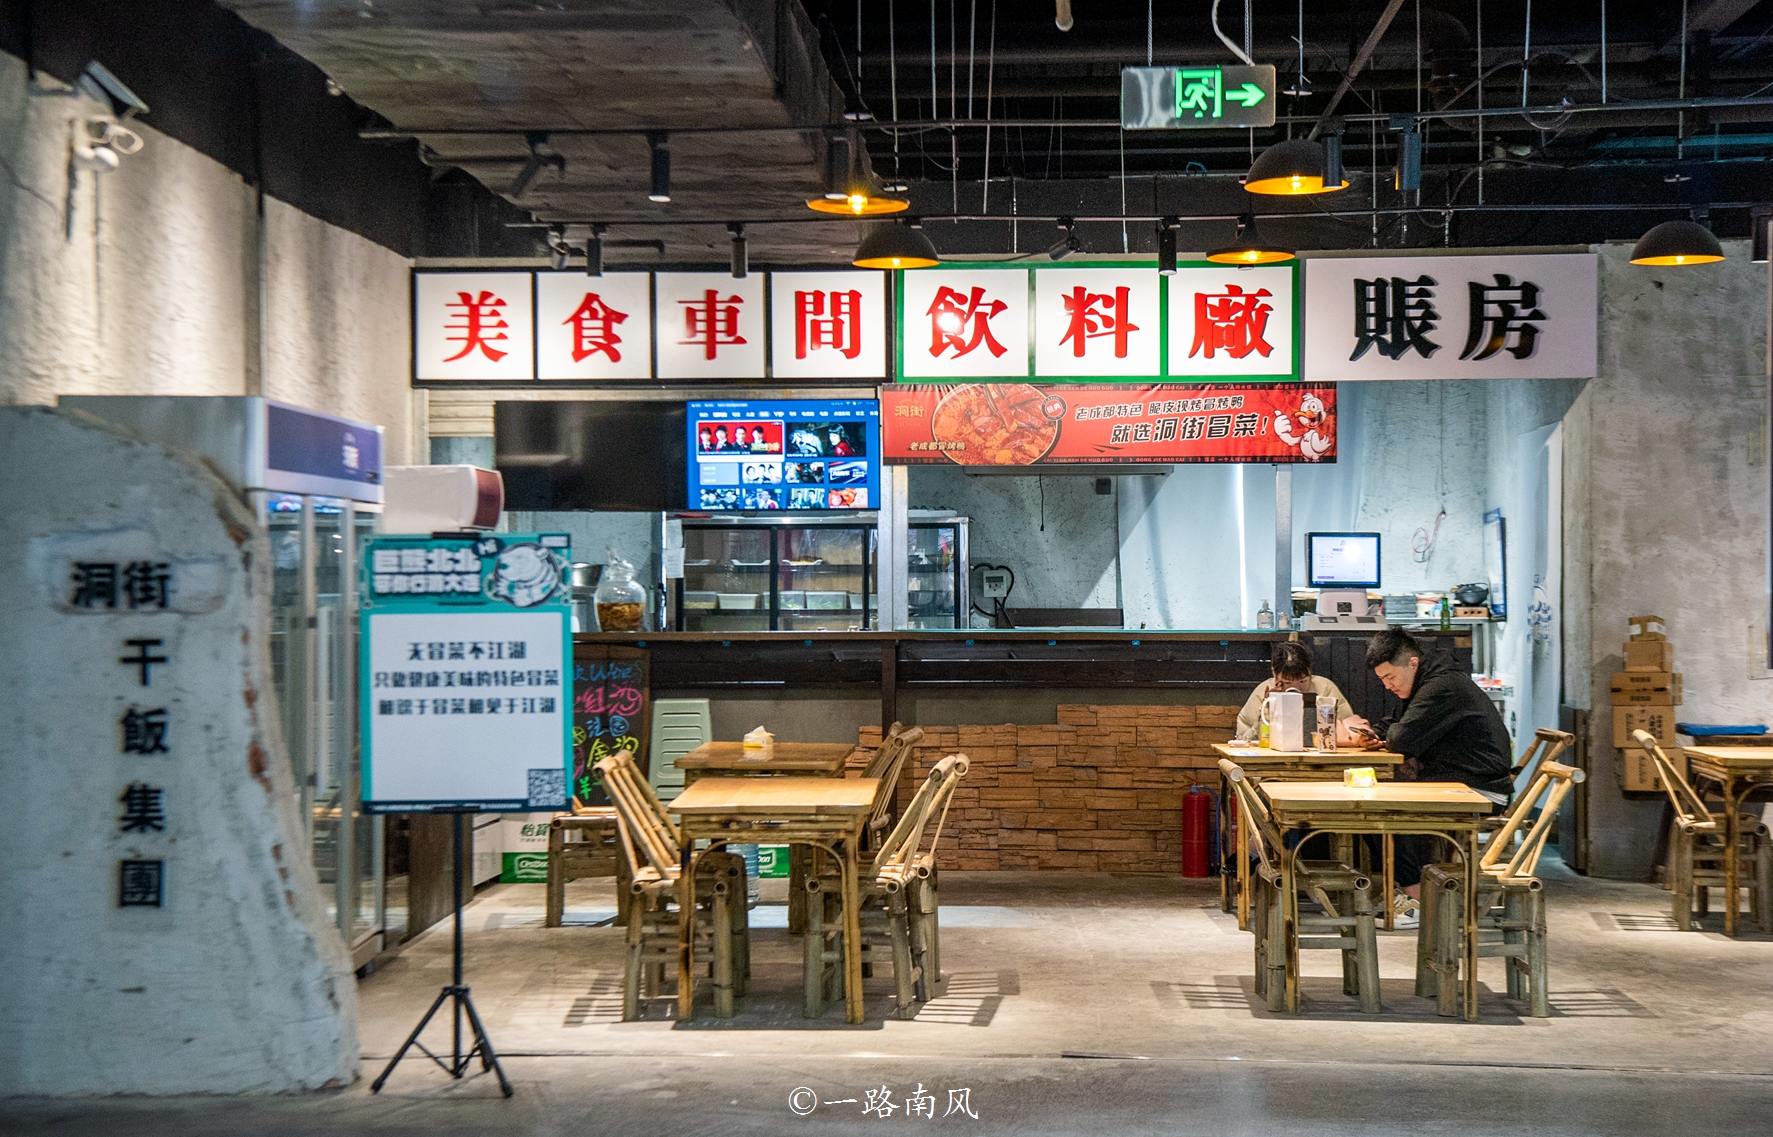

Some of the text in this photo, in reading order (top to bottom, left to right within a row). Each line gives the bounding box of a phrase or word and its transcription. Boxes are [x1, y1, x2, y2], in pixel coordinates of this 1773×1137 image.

[443, 289, 863, 363] 美食車間
[925, 283, 1274, 360] 飲料廠
[1348, 273, 1549, 362] 賬房
[894, 405, 924, 418] 洞街
[1075, 402, 1142, 420] 老成都特色
[1148, 395, 1244, 416] 脆皮现烤冒烤鸭
[1110, 412, 1269, 444] 就选洞街冒菜!
[70, 560, 172, 609] 洞街
[407, 641, 527, 661] 无冒菜不江湖
[117, 637, 170, 908] 干飯集團
